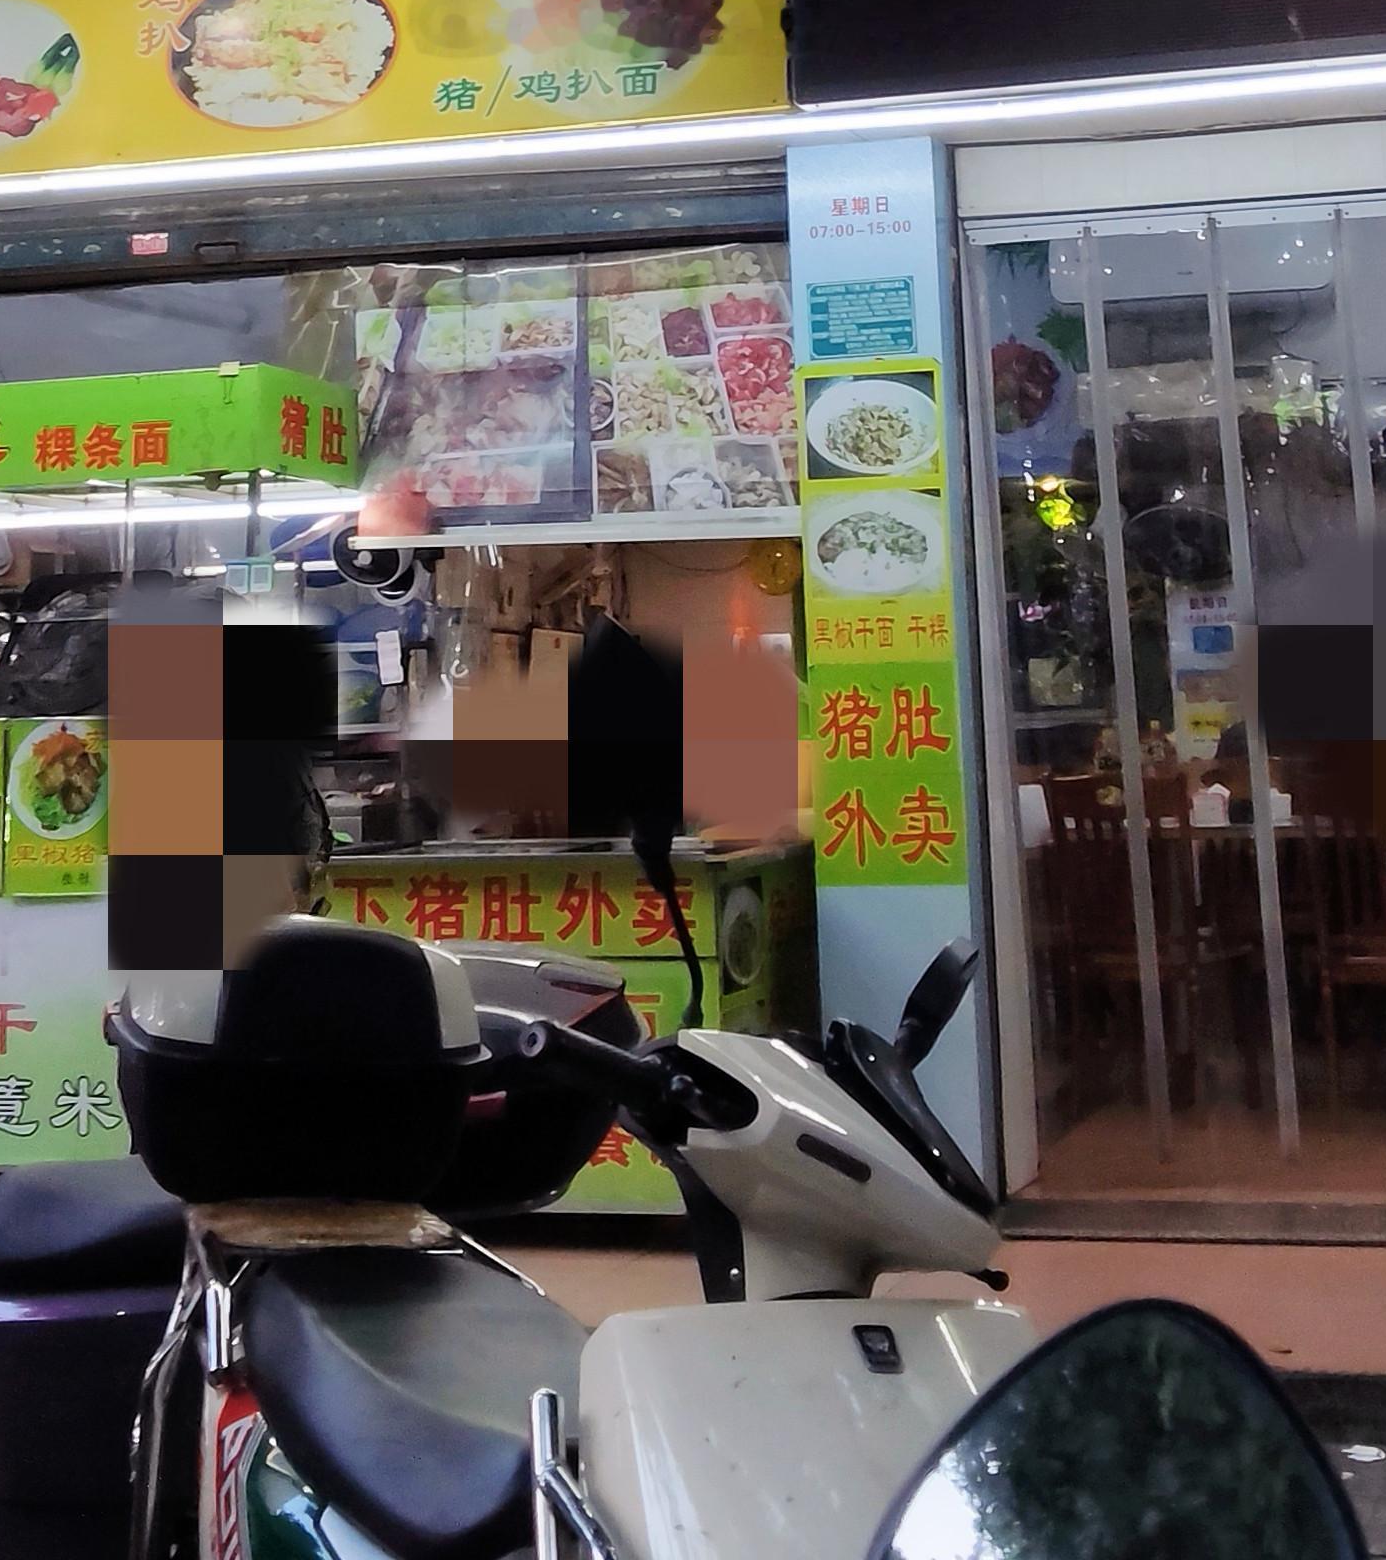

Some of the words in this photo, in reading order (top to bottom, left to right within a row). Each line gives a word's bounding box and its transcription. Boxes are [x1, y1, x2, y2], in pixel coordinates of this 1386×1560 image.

[432, 60, 666, 118] 猪/鸡扒面
[809, 220, 912, 239] 07:00-15:00
[830, 196, 890, 217] 星期日
[34, 420, 172, 473] 粿条面
[280, 394, 348, 466] 猪肚
[813, 615, 896, 650] 黑椒干面
[818, 683, 952, 761] 猪肚
[821, 784, 958, 868] 外卖
[11, 843, 109, 866] 黑椒猪
[333, 872, 697, 948] 下猪肚外卖
